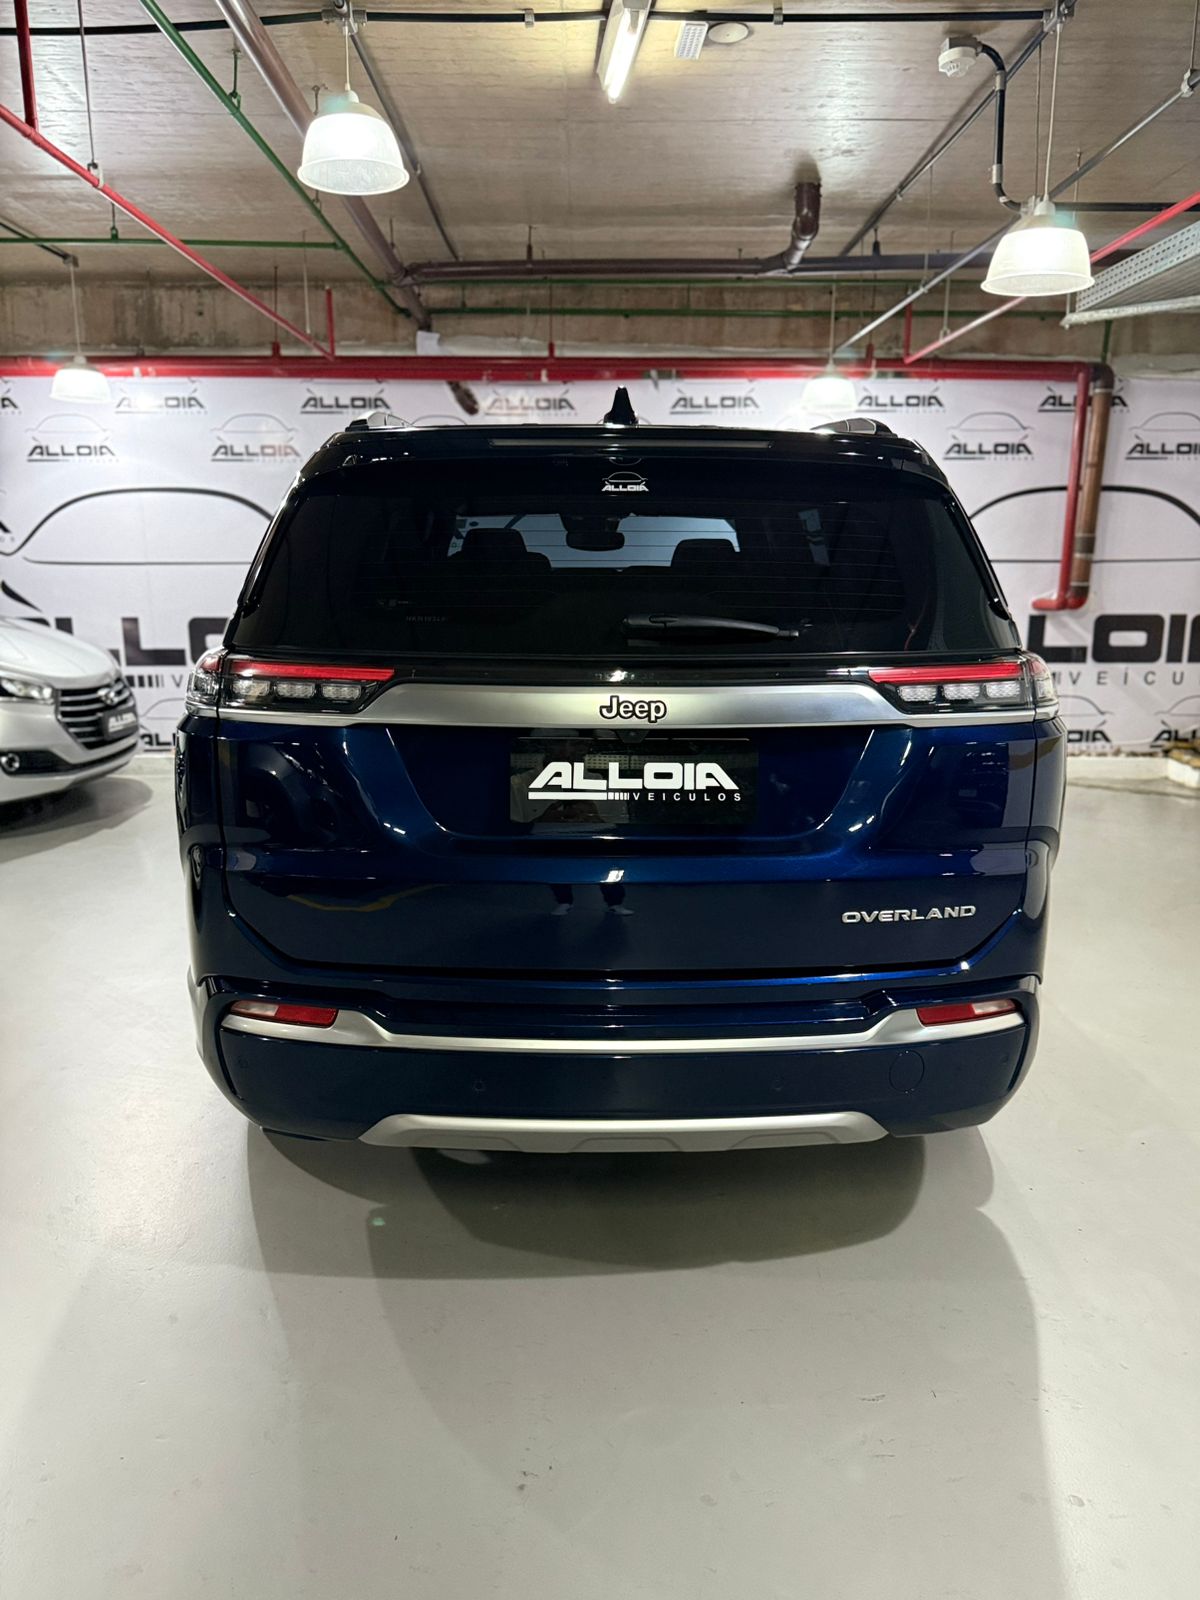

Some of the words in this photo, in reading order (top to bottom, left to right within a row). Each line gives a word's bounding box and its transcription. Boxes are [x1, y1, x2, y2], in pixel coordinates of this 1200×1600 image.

[115, 396, 205, 409] AOIA
[301, 396, 391, 409] ALLOIA
[487, 397, 576, 410] ALLOIA
[671, 396, 760, 409] ALLOIA
[857, 395, 945, 407] ALLOIA
[28, 445, 116, 457] ALLOIA
[212, 445, 301, 457] ALLOIA
[945, 443, 1033, 455] ALLOIA
[1127, 443, 1200, 455] ALLOI
[600, 695, 667, 722] Jeep
[528, 761, 740, 791] ALLOIA
[632, 792, 742, 801] VEICULOS
[841, 905, 976, 923] OVERLAND
